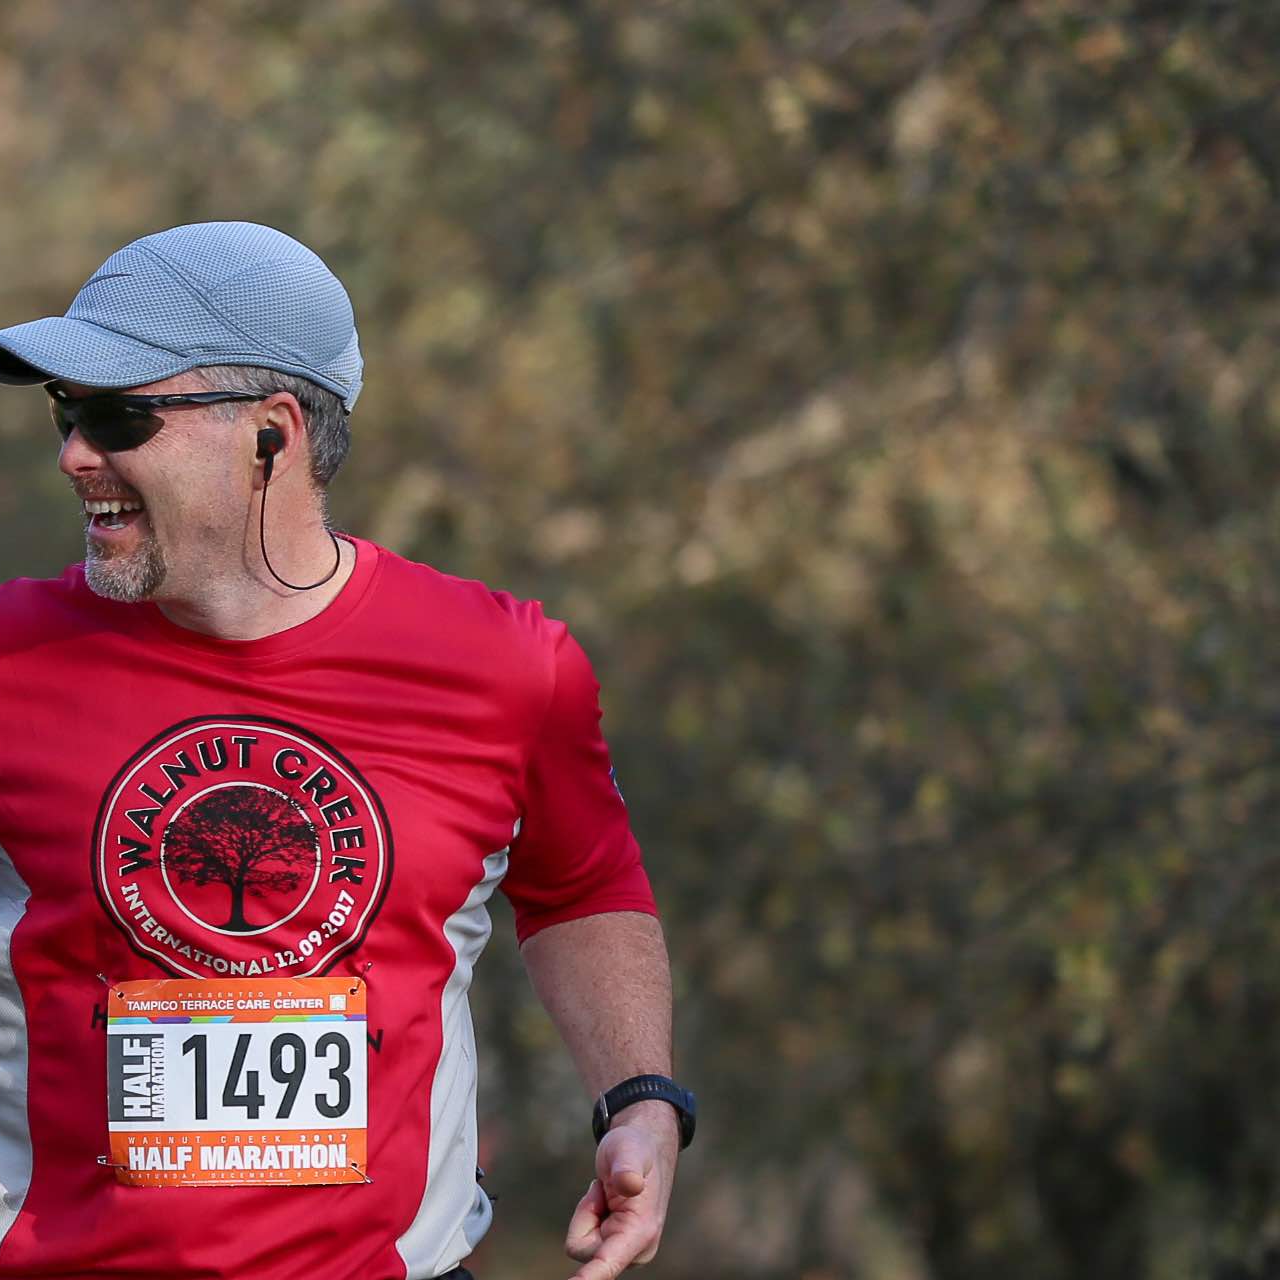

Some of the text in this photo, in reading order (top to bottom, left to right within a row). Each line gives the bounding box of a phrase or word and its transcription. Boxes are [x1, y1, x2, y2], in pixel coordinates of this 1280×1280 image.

[117, 736, 366, 884] WALNUT CREEK
[121, 883, 356, 976] INTERNATIONAL 12.09.2017
[127, 998, 324, 1011] TAMPICO TERRACE CARE CENTER
[123, 1038, 151, 1117] HALF
[151, 1038, 165, 1117] MARATHON
[182, 1031, 351, 1120] 1493
[128, 1134, 348, 1144] WALNUT CREEK 2017
[128, 1144, 347, 1171] HALF MARATHON
